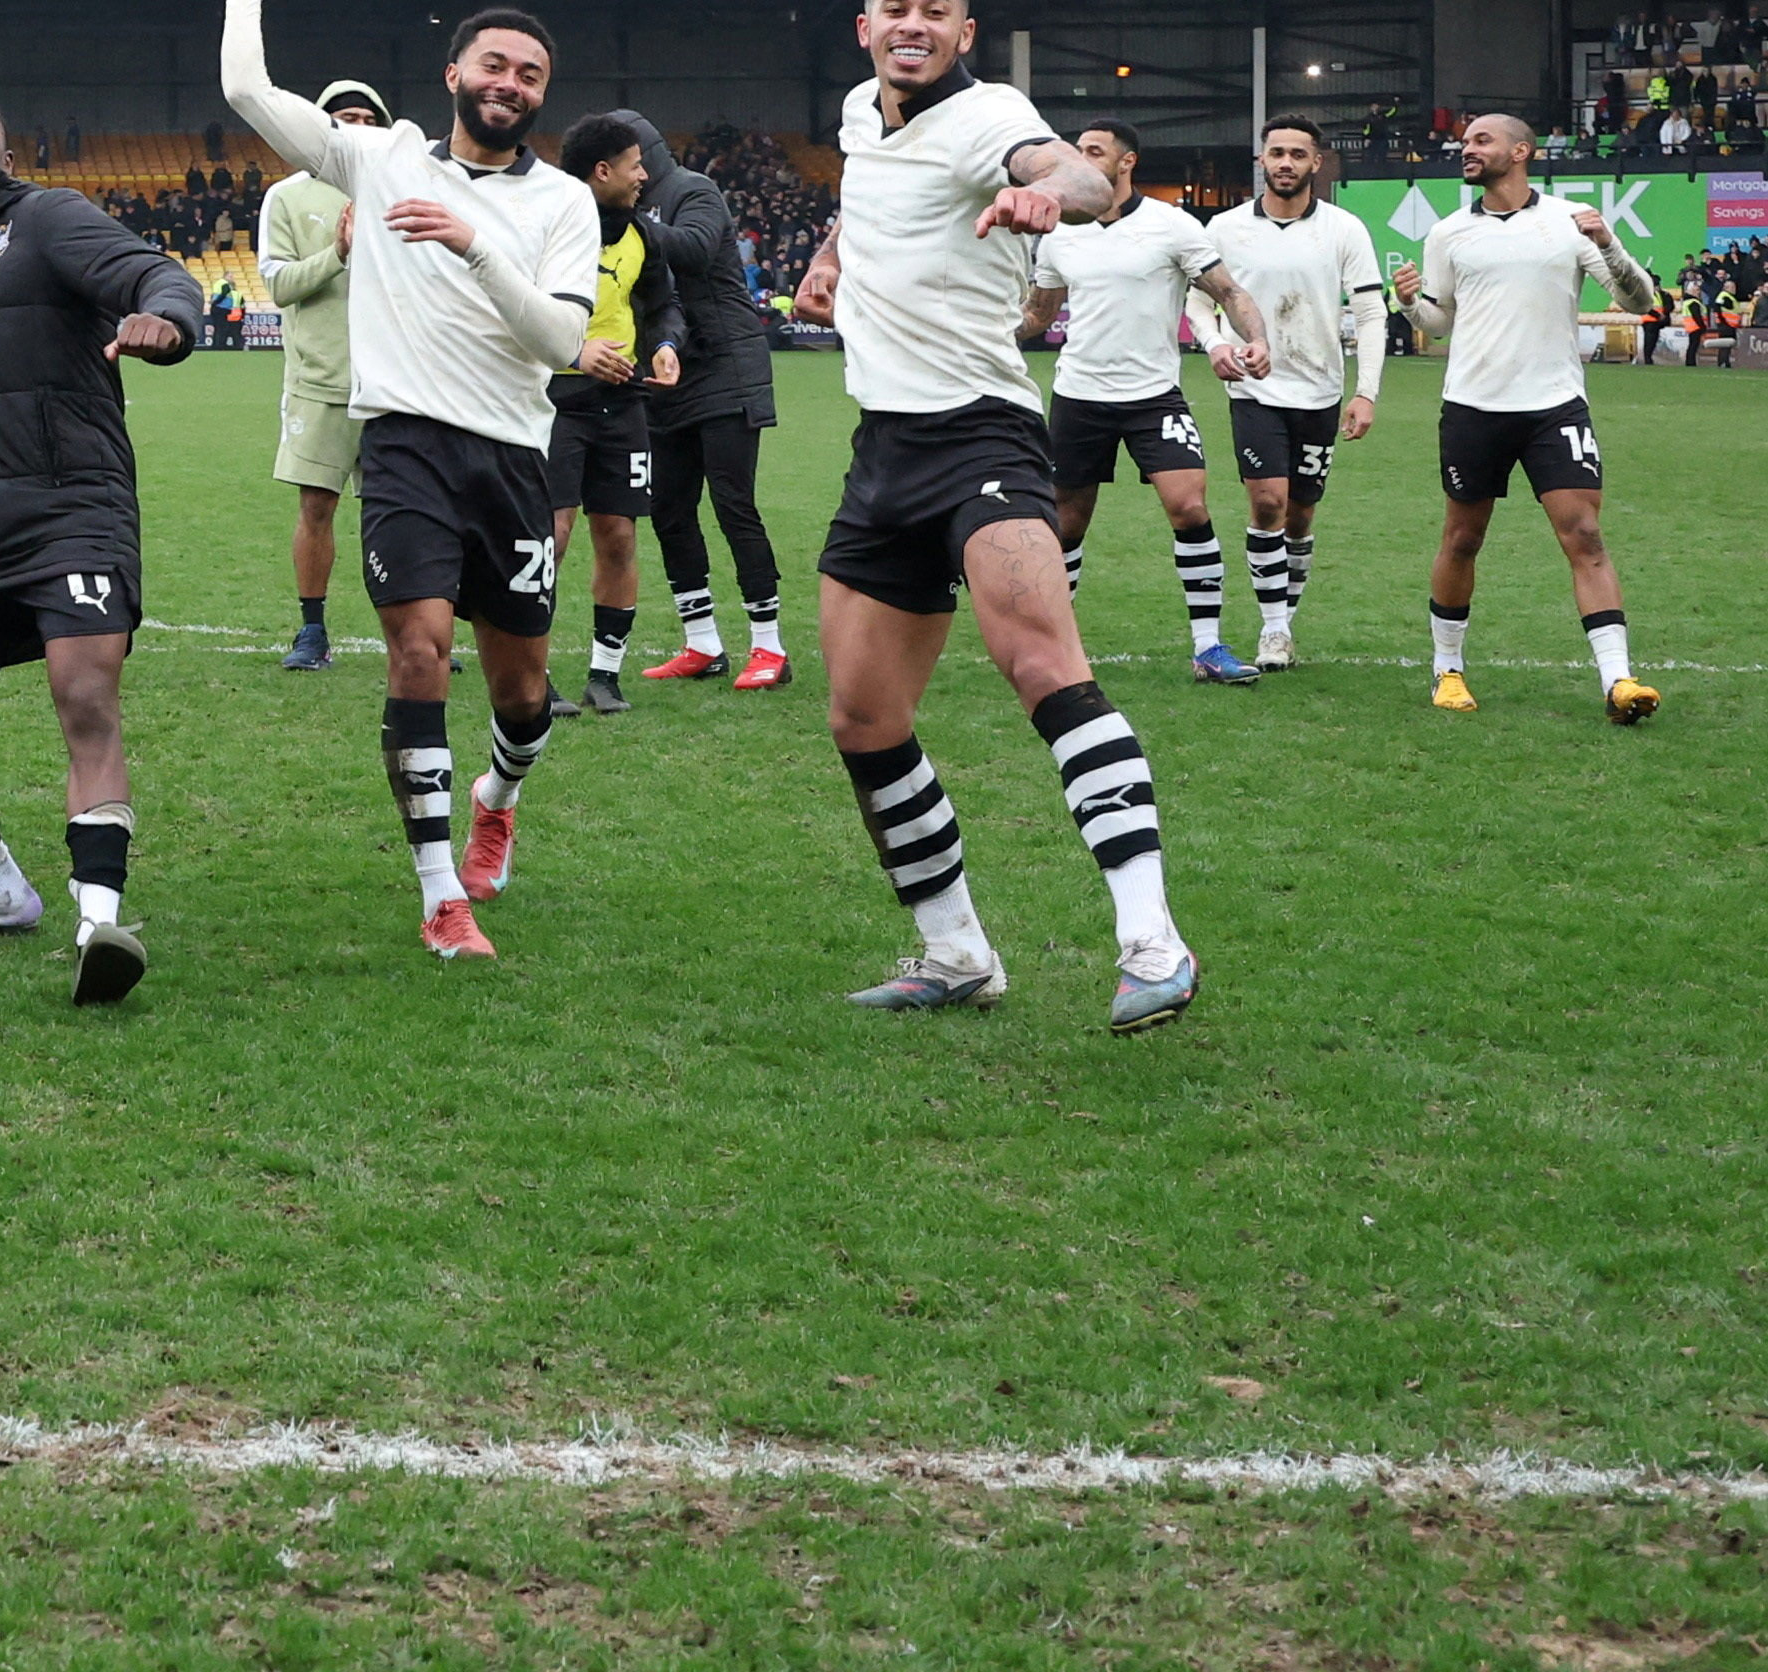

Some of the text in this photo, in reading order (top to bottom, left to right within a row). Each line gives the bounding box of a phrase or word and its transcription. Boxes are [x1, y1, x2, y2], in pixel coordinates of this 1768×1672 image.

[1713, 180, 1768, 192] Mortgag
[1713, 207, 1765, 220] Savings
[244, 336, 284, 346] 28162
[1161, 414, 1202, 445] 45
[1560, 425, 1601, 462] 14
[509, 535, 555, 594] 28
